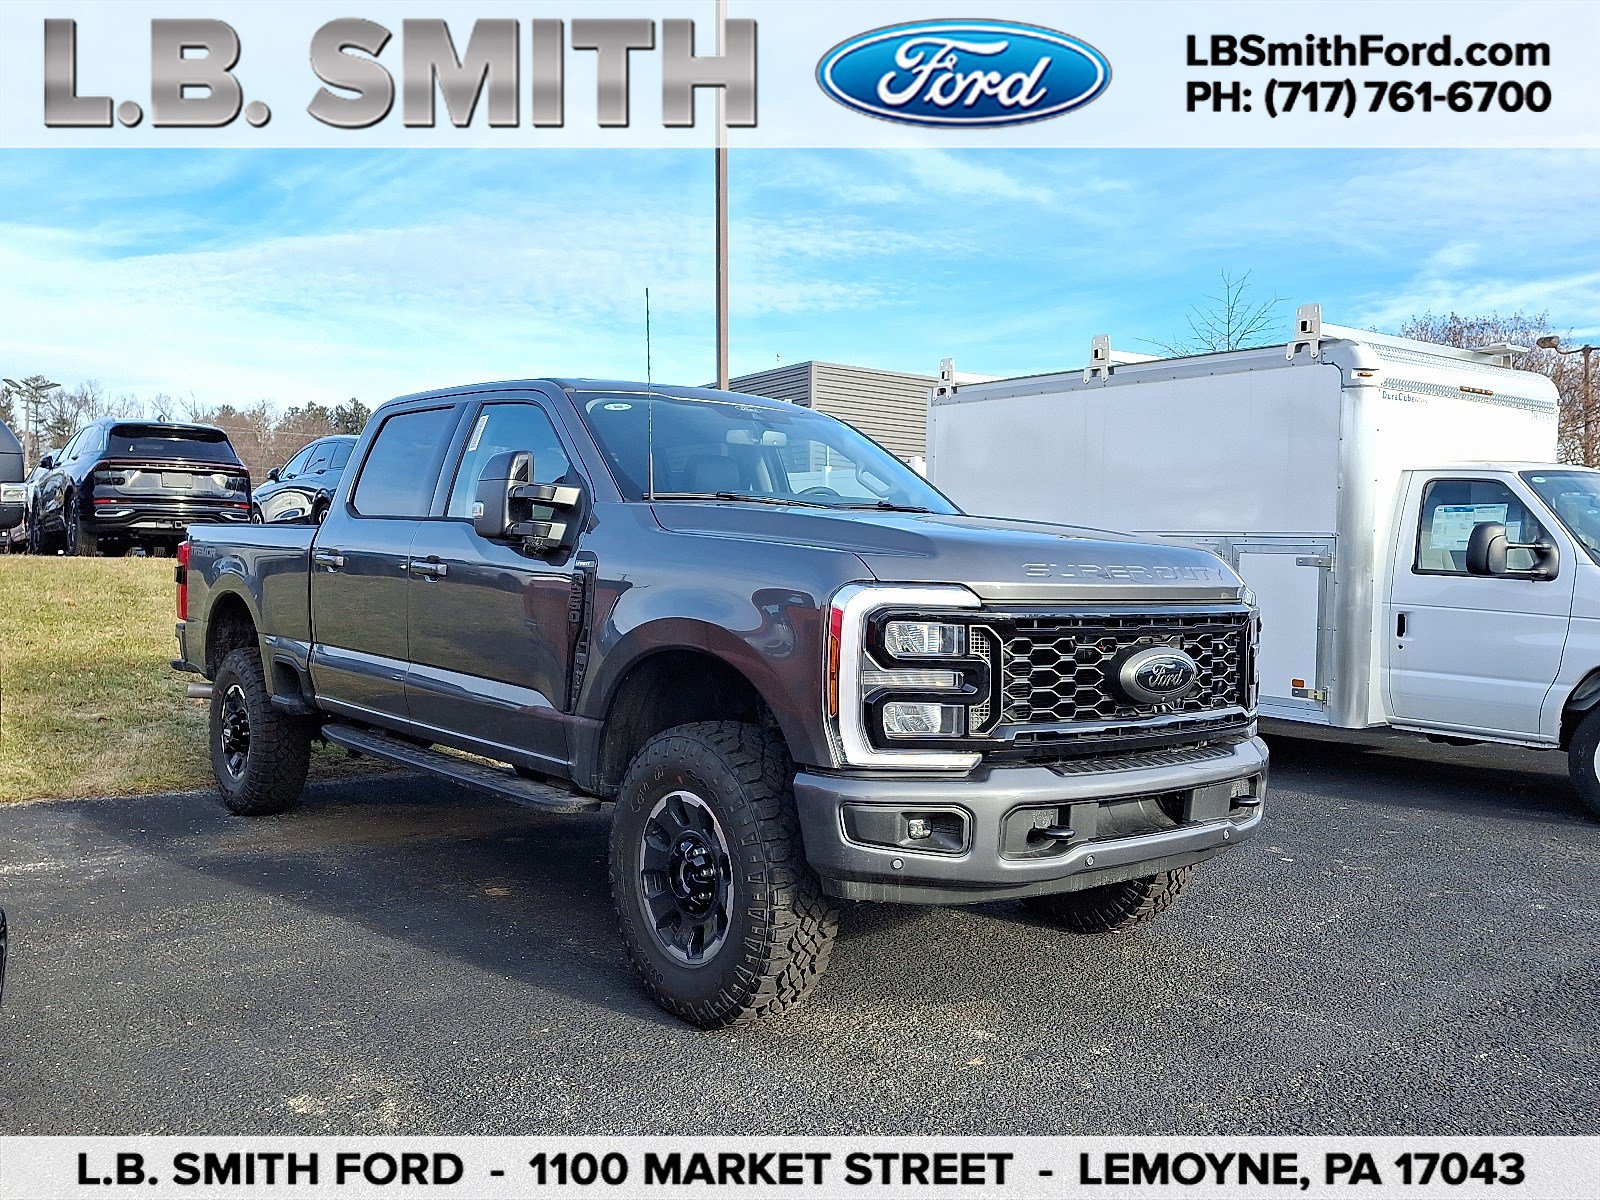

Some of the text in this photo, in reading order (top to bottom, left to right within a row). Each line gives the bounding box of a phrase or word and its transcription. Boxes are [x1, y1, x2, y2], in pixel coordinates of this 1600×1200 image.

[1022, 562, 1224, 581] SUPER DUTY
[1148, 663, 1184, 688] Ford
